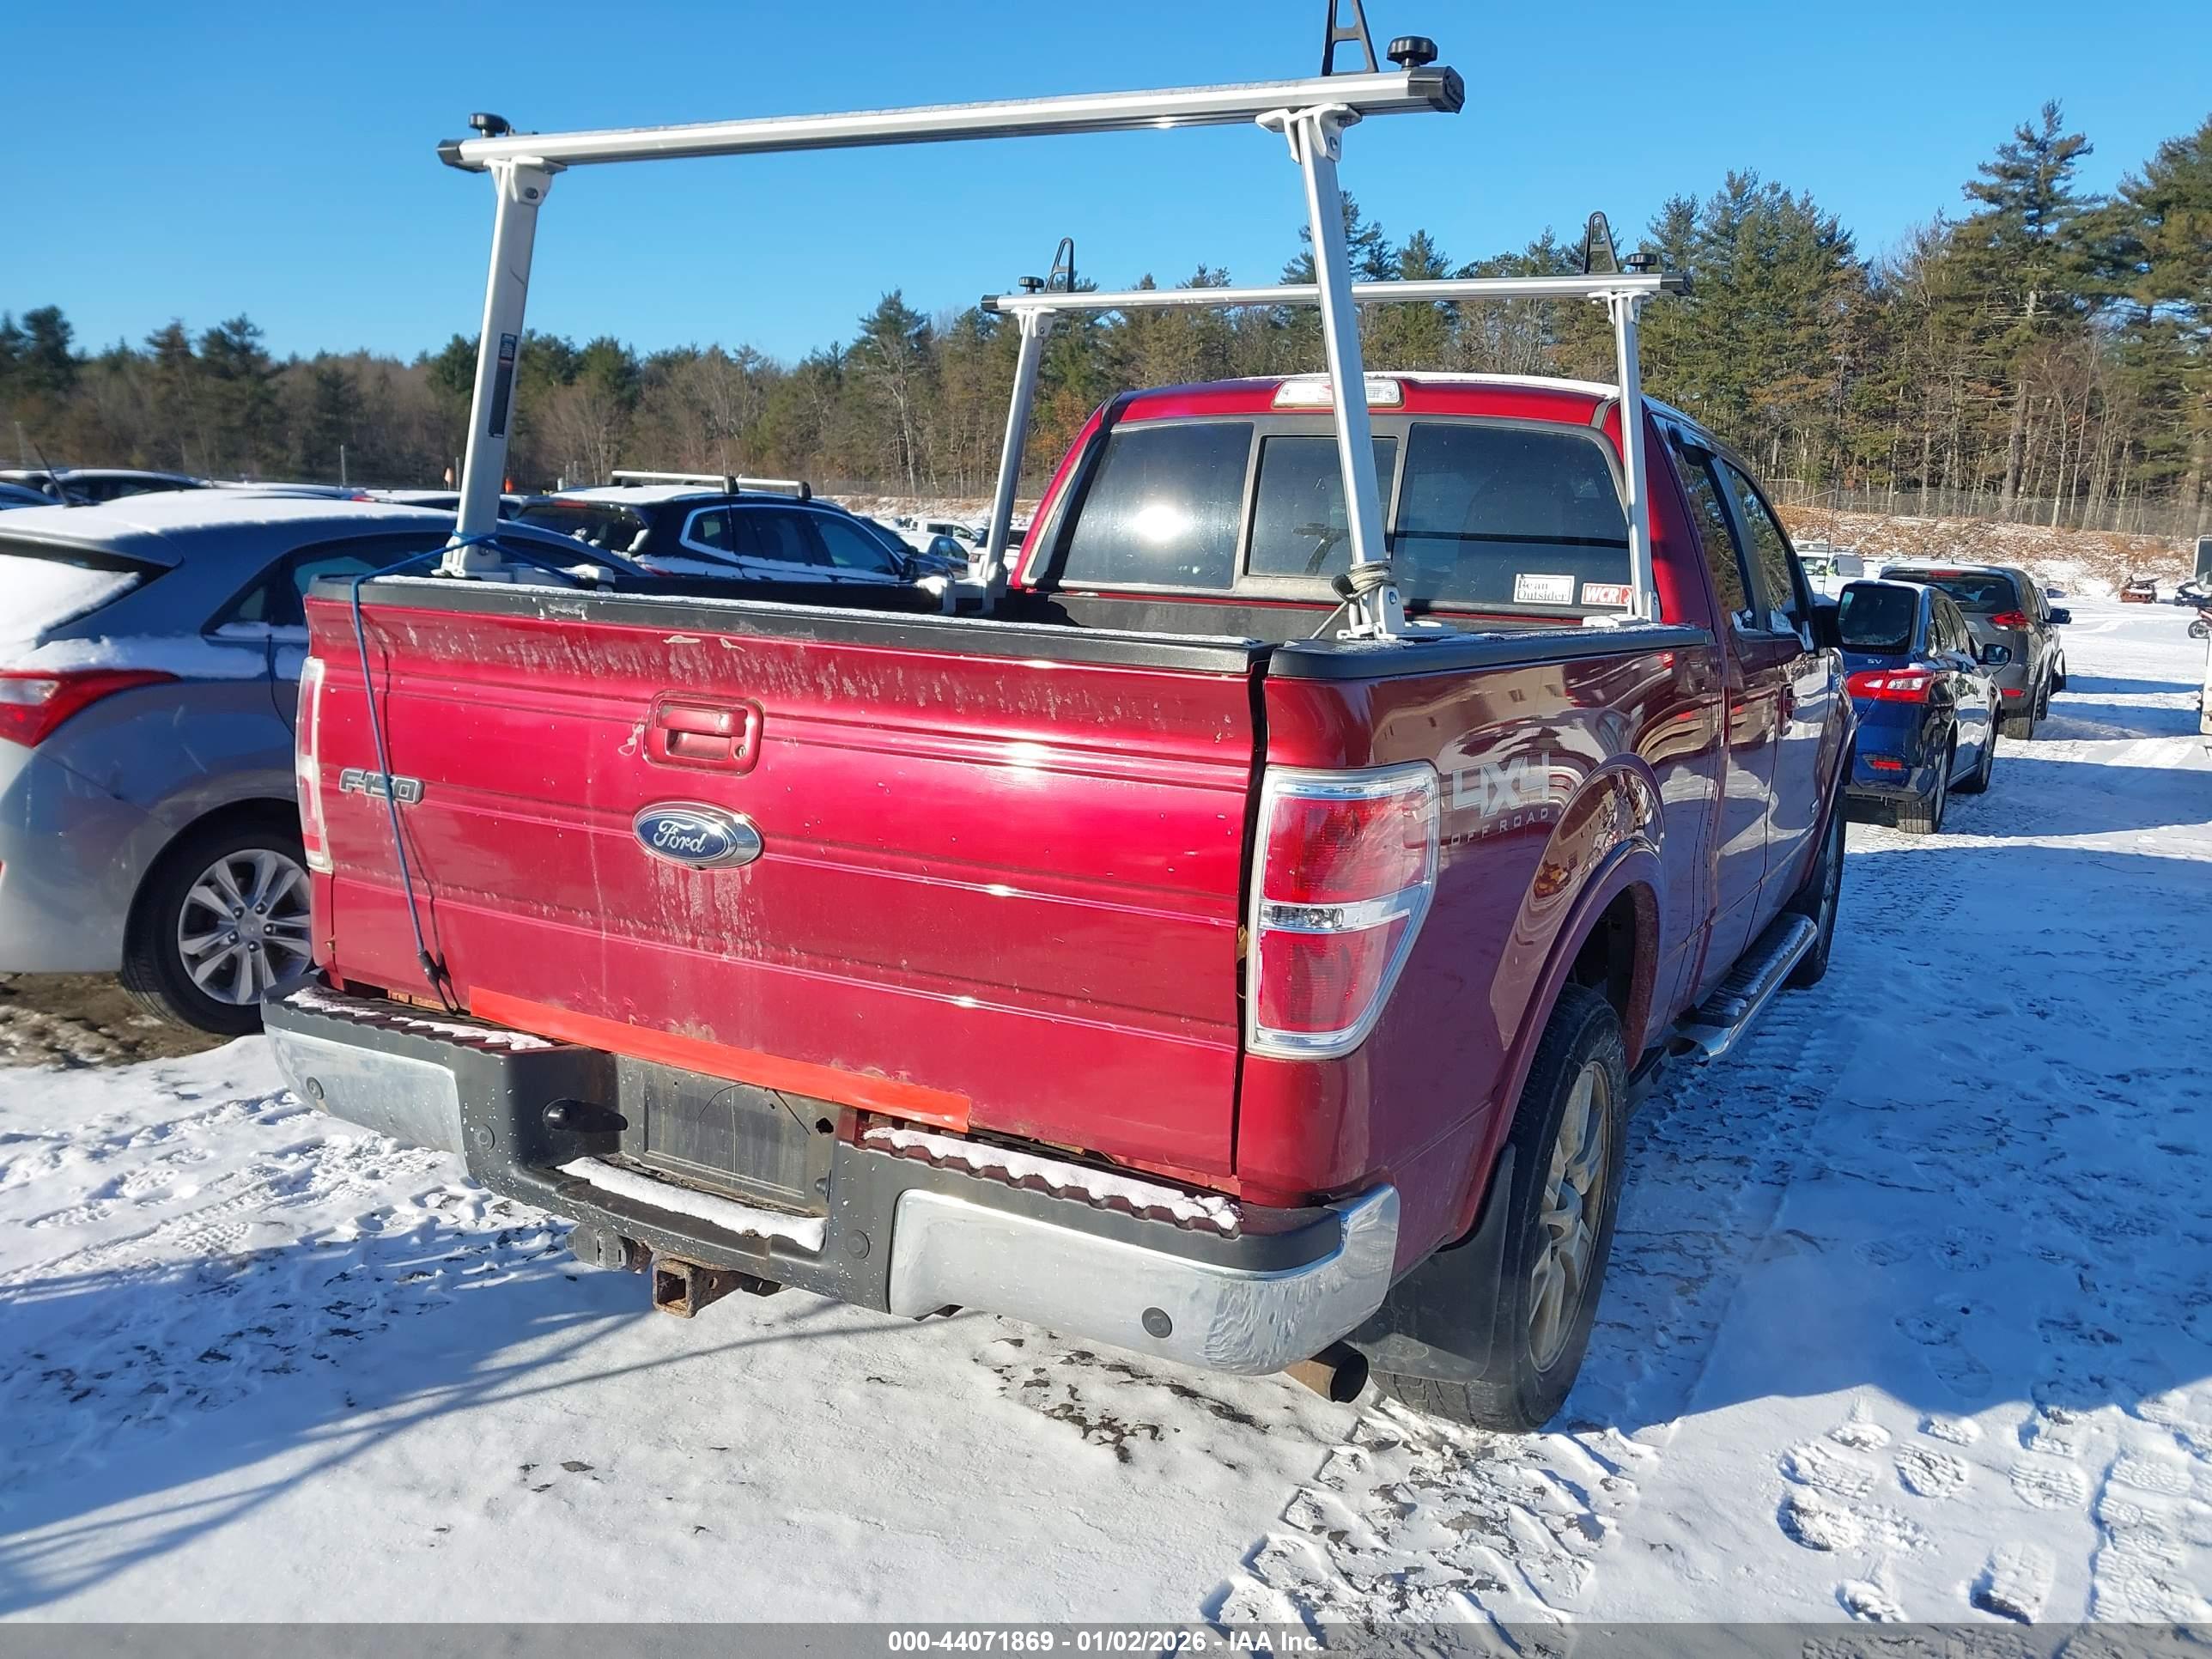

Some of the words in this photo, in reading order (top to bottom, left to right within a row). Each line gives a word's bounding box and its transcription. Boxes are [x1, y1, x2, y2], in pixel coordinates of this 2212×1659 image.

[1585, 586, 1620, 604] WCR
[653, 820, 708, 854] Ford
[1450, 824, 1491, 846] OFF
[1499, 807, 1548, 833] ROAD
